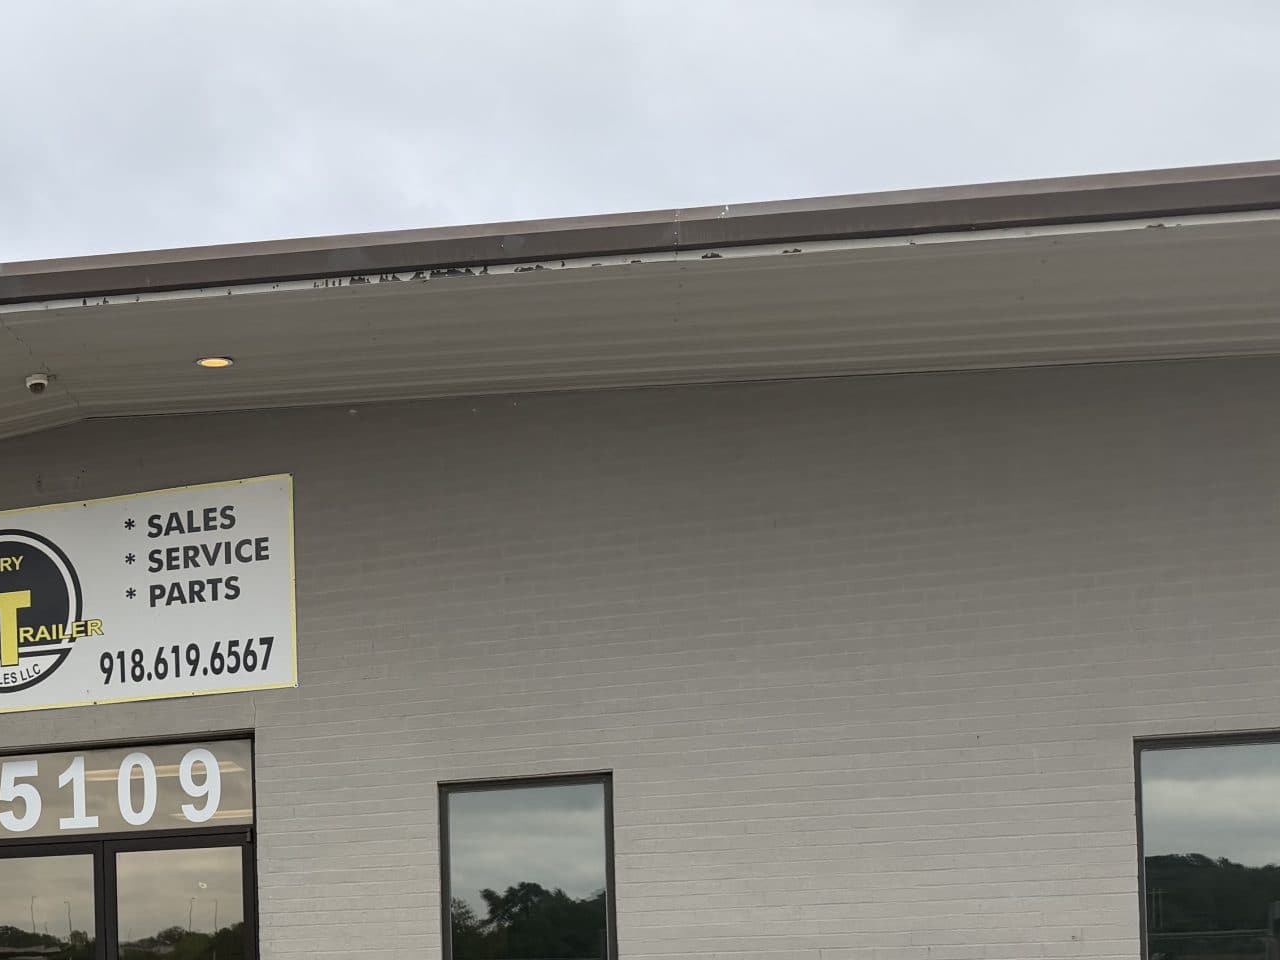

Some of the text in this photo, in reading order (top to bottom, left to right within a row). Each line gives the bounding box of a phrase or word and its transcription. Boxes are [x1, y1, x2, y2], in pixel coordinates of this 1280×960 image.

[147, 505, 236, 538] SALES
[148, 536, 270, 573] SERVICE
[149, 575, 241, 608] PARTS
[20, 663, 41, 682] LLC
[99, 636, 274, 685] 918.619.6567
